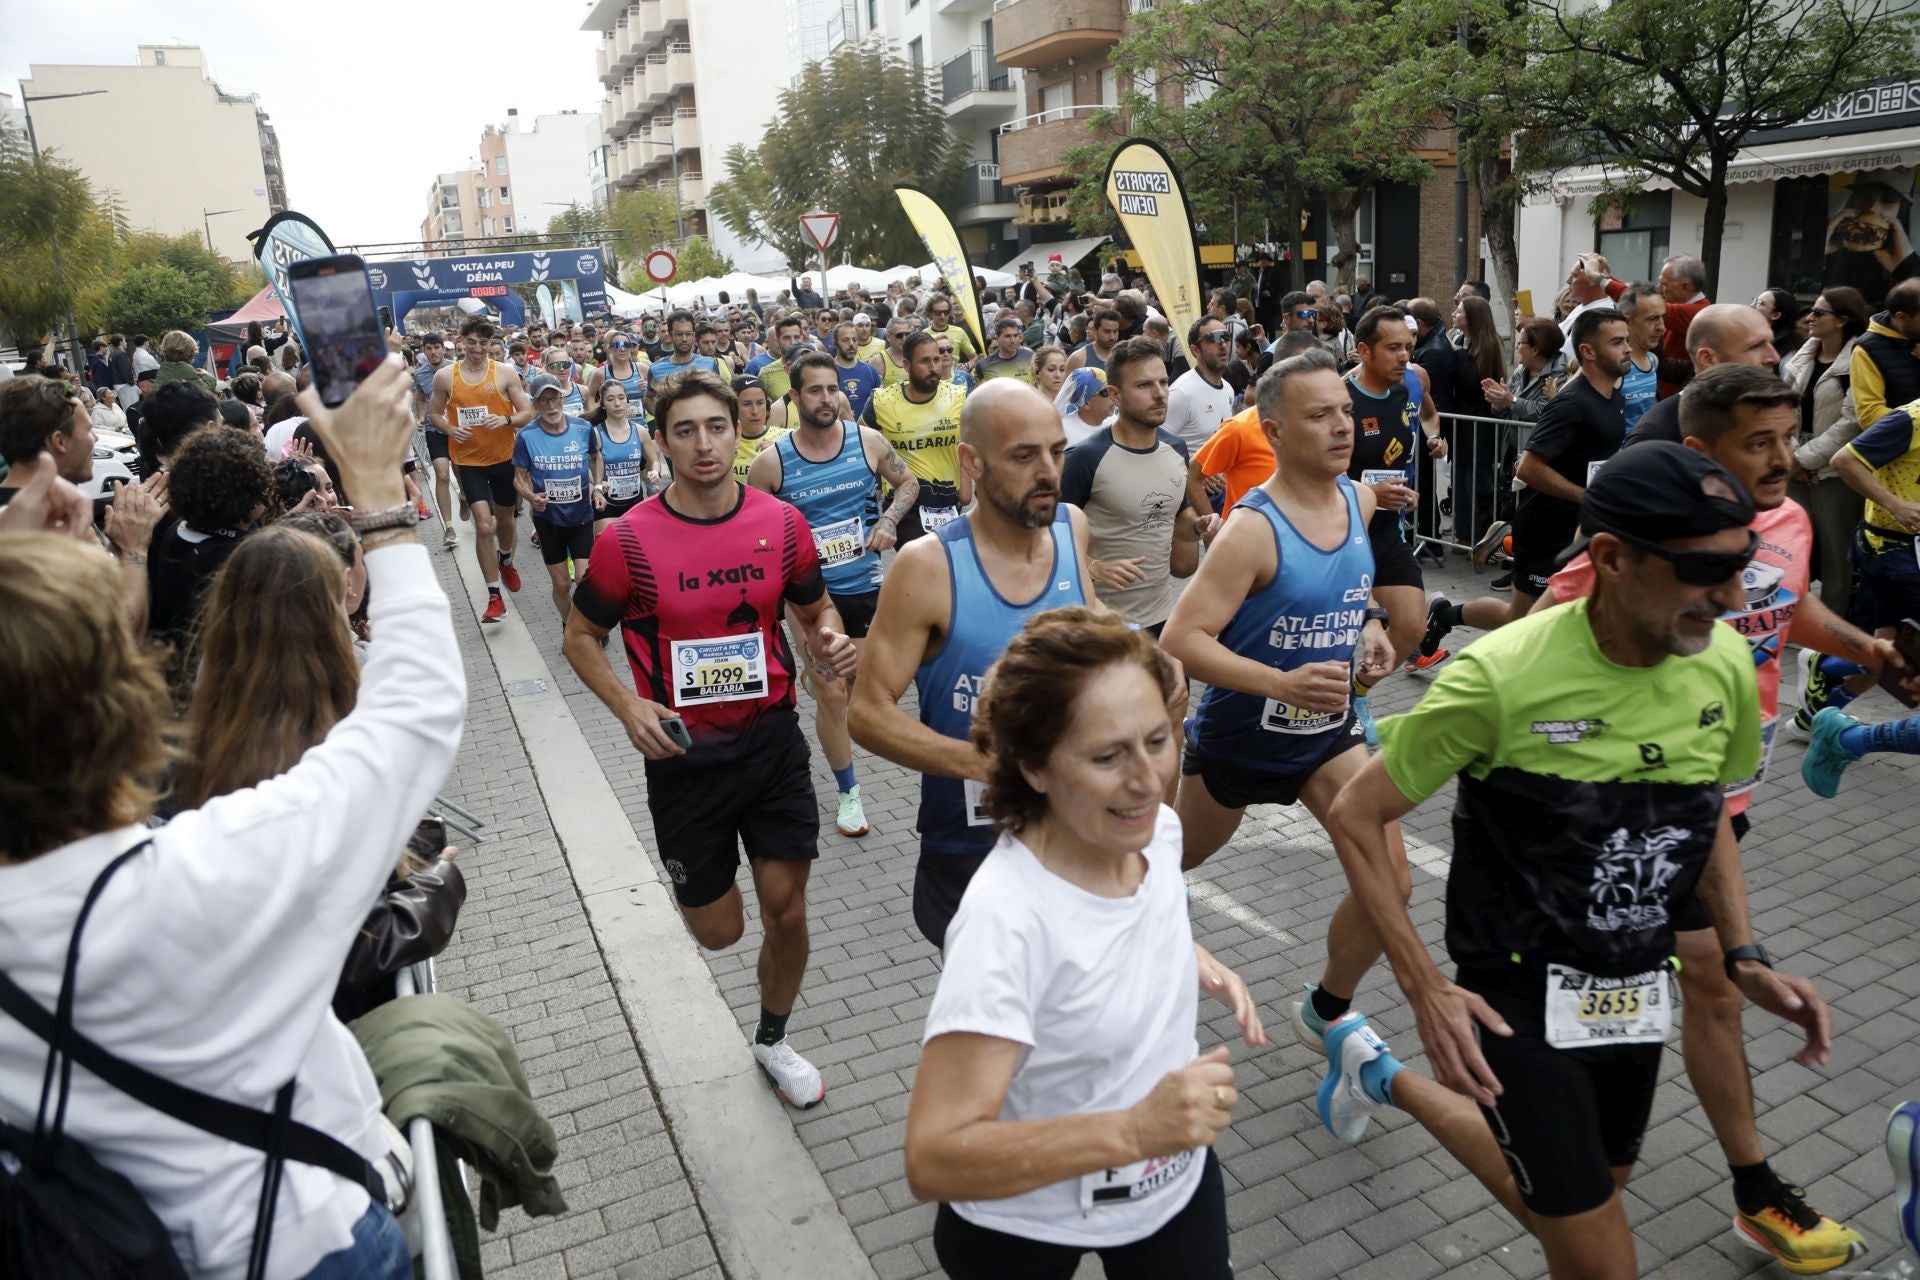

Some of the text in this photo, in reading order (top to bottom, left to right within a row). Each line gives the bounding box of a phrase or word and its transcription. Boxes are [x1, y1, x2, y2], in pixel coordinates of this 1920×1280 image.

[1773, 162, 1832, 176] PASTELERÍA
[1842, 155, 1903, 169] CAFETERÍA
[451, 260, 515, 272] VOLTA A PEU
[466, 271, 503, 283] DÉNIA
[605, 460, 640, 470] ATLETISM
[826, 540, 852, 556] 1183
[678, 564, 765, 592] la xara
[1272, 609, 1364, 633] ATLETISM
[1269, 628, 1361, 650] BENIDOR
[699, 646, 723, 654] CIRCUIT
[685, 667, 743, 685] S 1299
[700, 683, 744, 695] BALEARIA
[1276, 703, 1287, 715] D
[1582, 990, 1639, 1015] 3655
